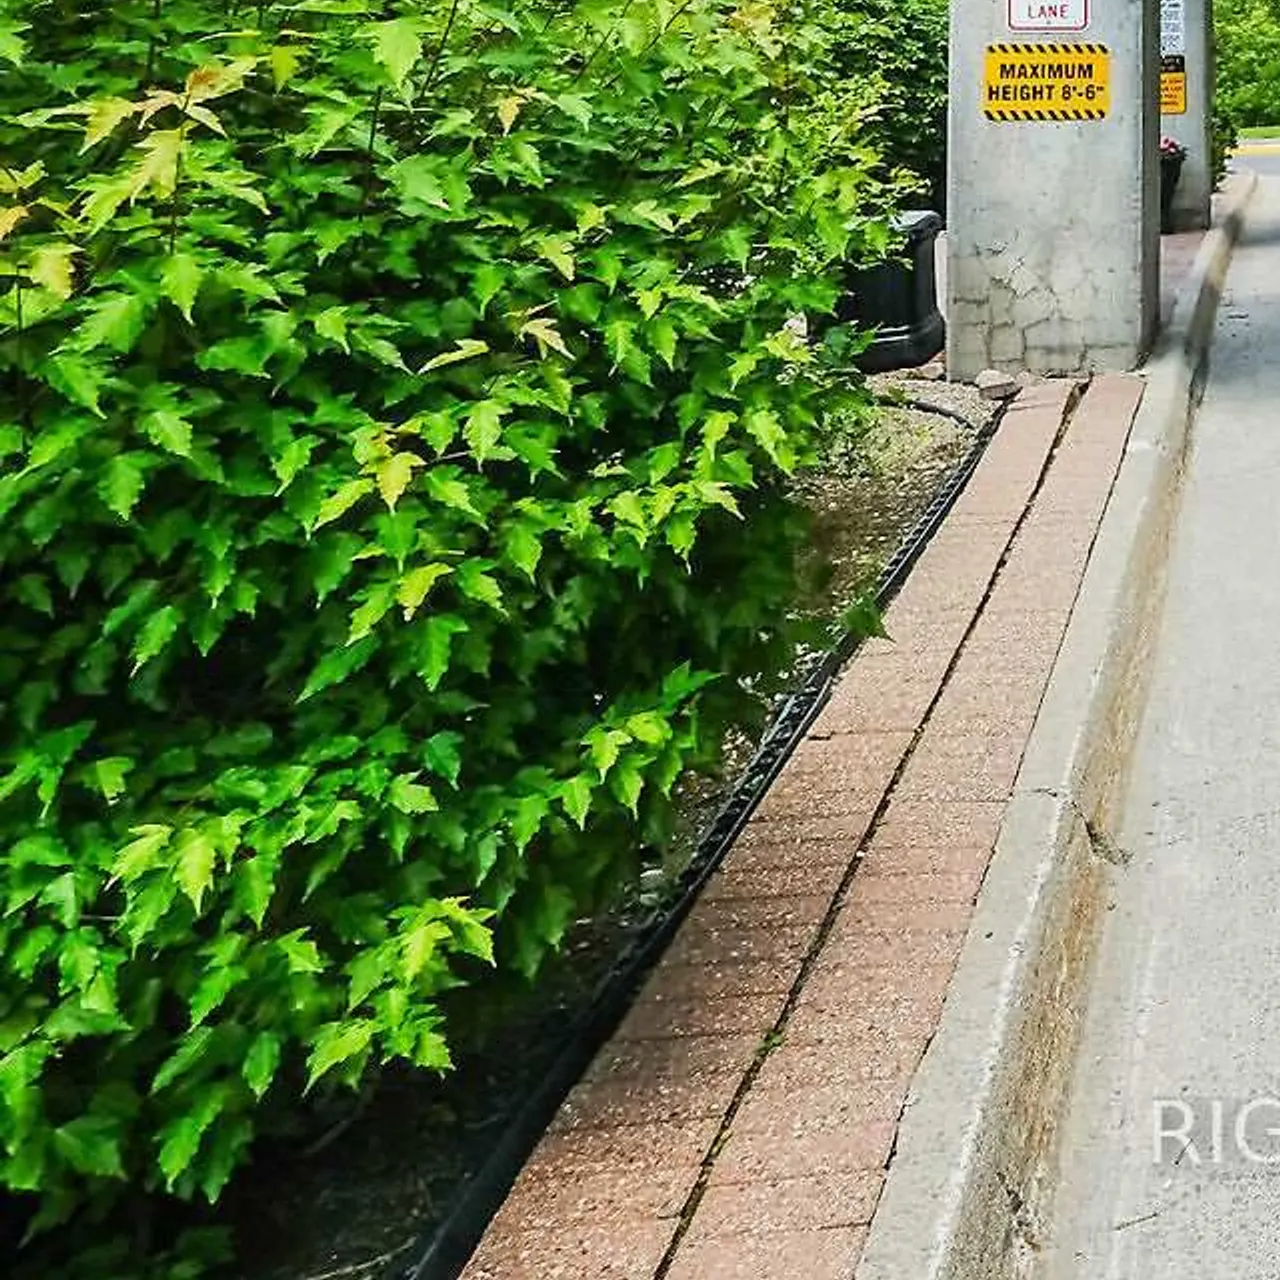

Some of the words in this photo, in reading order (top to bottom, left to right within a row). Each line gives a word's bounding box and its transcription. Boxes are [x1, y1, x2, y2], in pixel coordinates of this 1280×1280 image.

[1027, 4, 1068, 19] LANE
[999, 63, 1094, 80] MAXIMUM
[988, 85, 1058, 102] HEIGHT
[1062, 85, 1105, 101] 8'-6"
